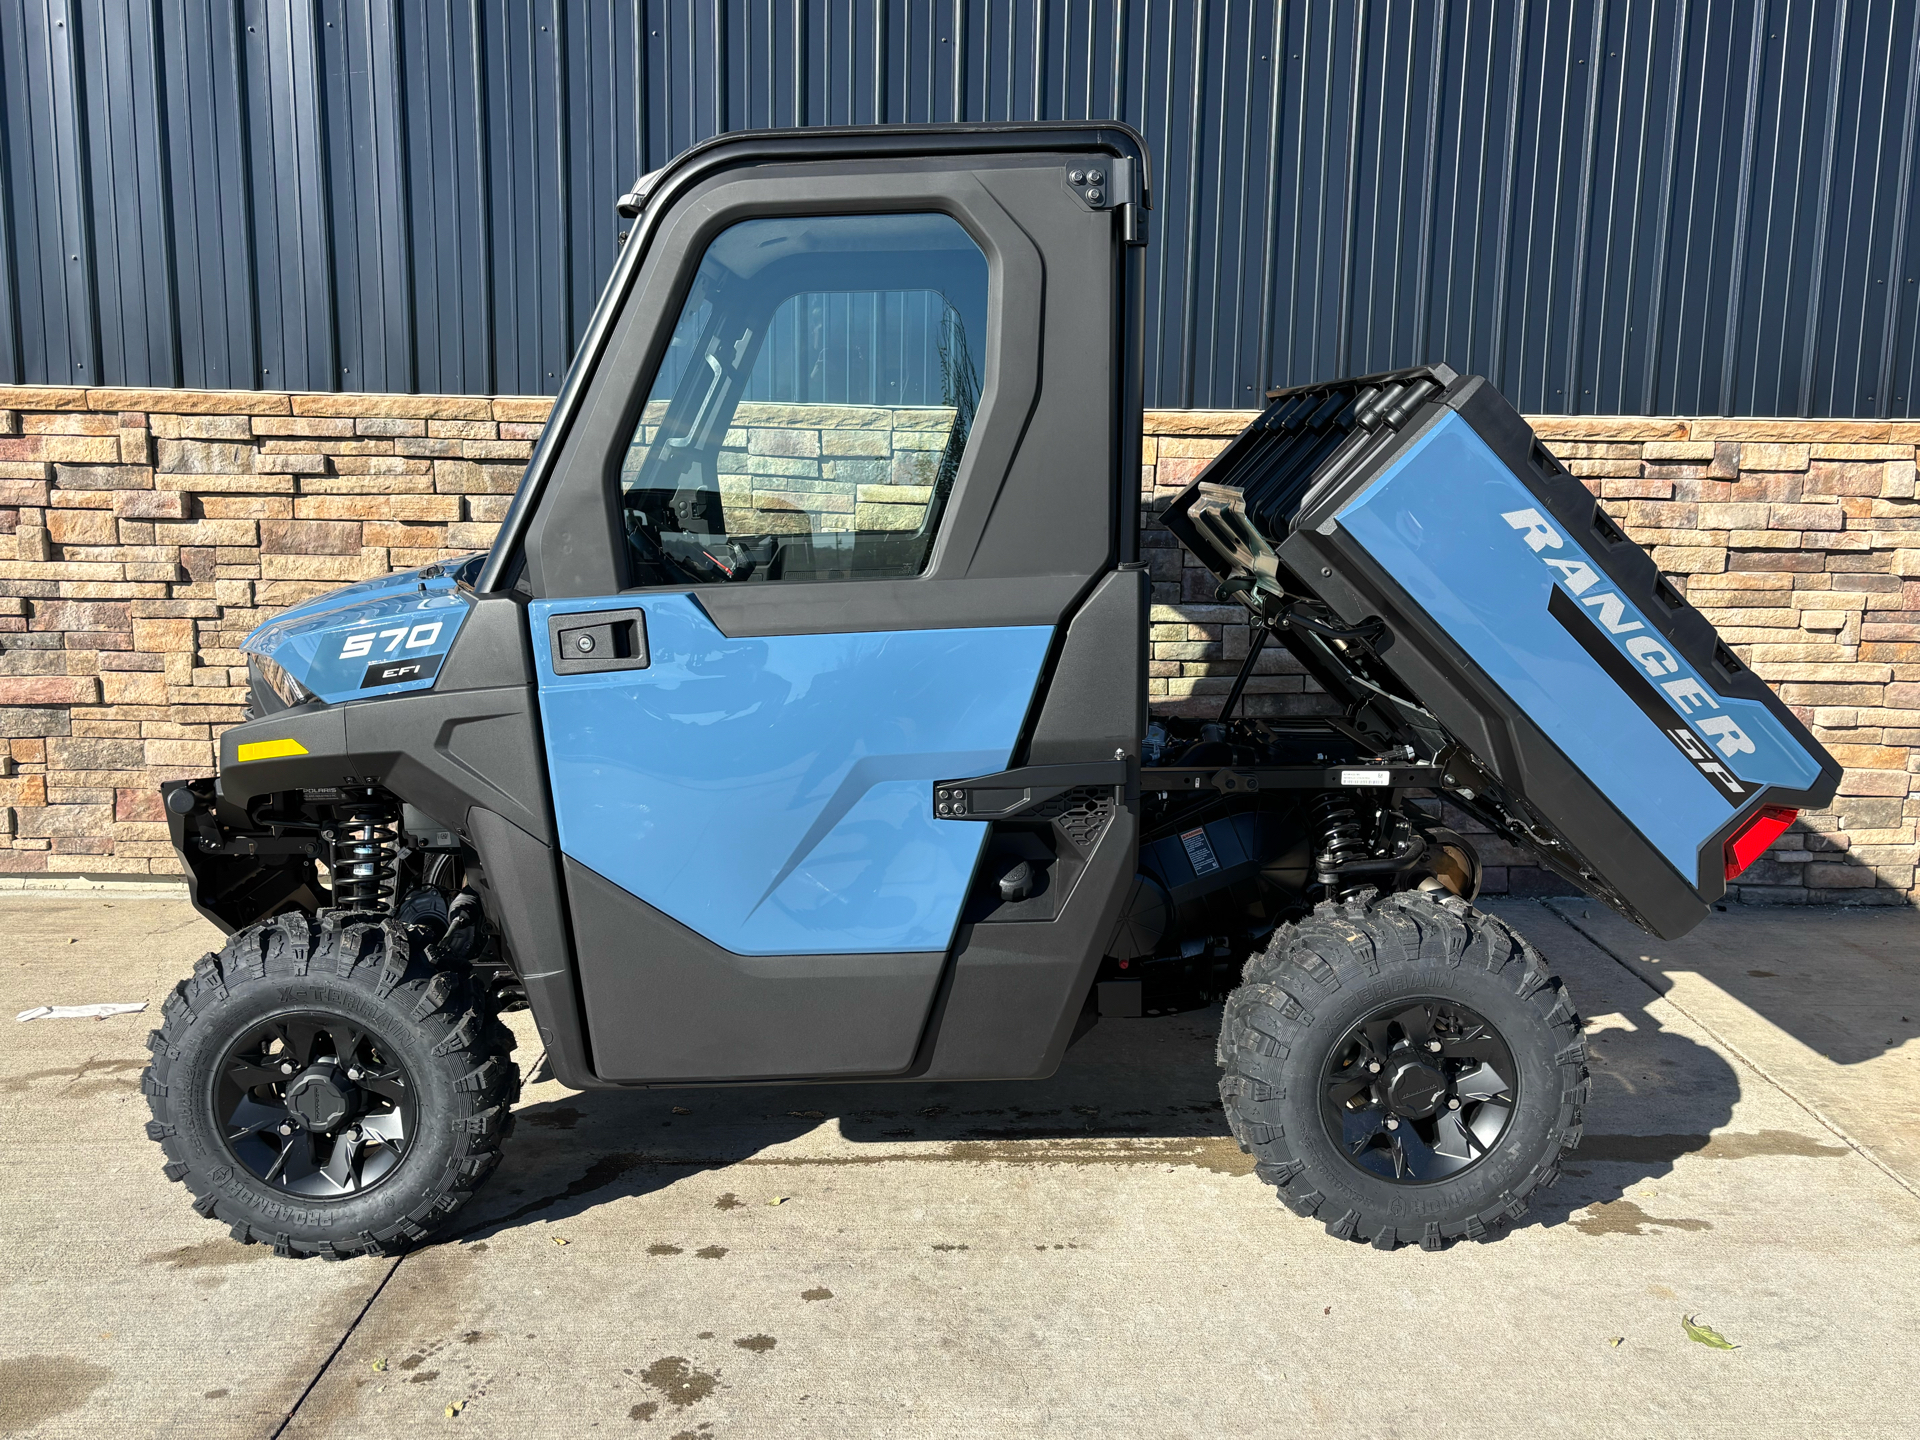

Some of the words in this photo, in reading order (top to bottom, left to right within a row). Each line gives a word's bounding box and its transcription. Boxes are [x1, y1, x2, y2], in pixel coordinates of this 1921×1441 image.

[339, 622, 443, 659] 570
[1501, 507, 1756, 758] RANGER
[382, 665, 420, 678] EFI
[1667, 729, 1746, 793] SP
[278, 986, 416, 1048] X-TERRAIN
[1318, 970, 1456, 1036] X-TERRAIN
